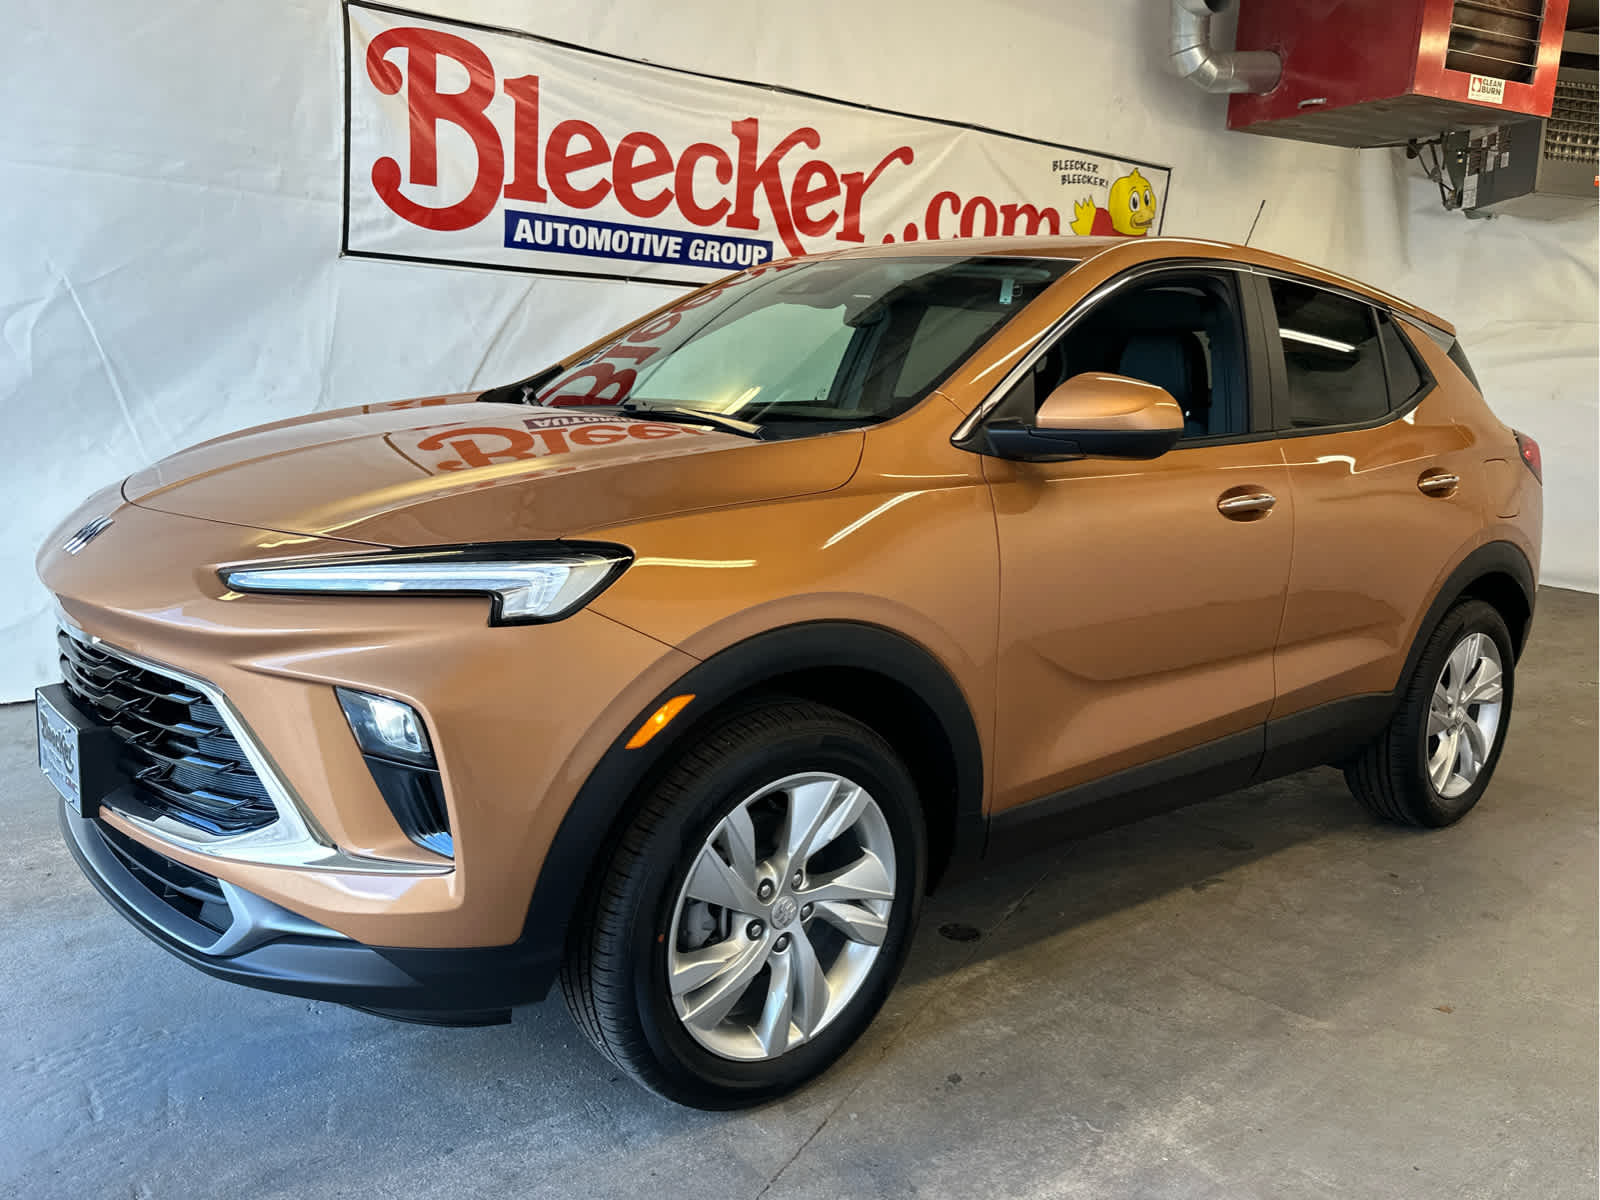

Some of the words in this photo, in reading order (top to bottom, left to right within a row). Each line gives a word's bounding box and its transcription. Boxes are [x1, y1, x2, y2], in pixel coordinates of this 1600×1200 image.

[1482, 78, 1502, 88] CLEAN
[1481, 86, 1501, 96] BURN
[1052, 159, 1098, 173] BLEECKER
[1061, 174, 1109, 189] BLEECKER!
[513, 218, 683, 259] AUTOMOTIVE
[688, 239, 768, 266] GROUP
